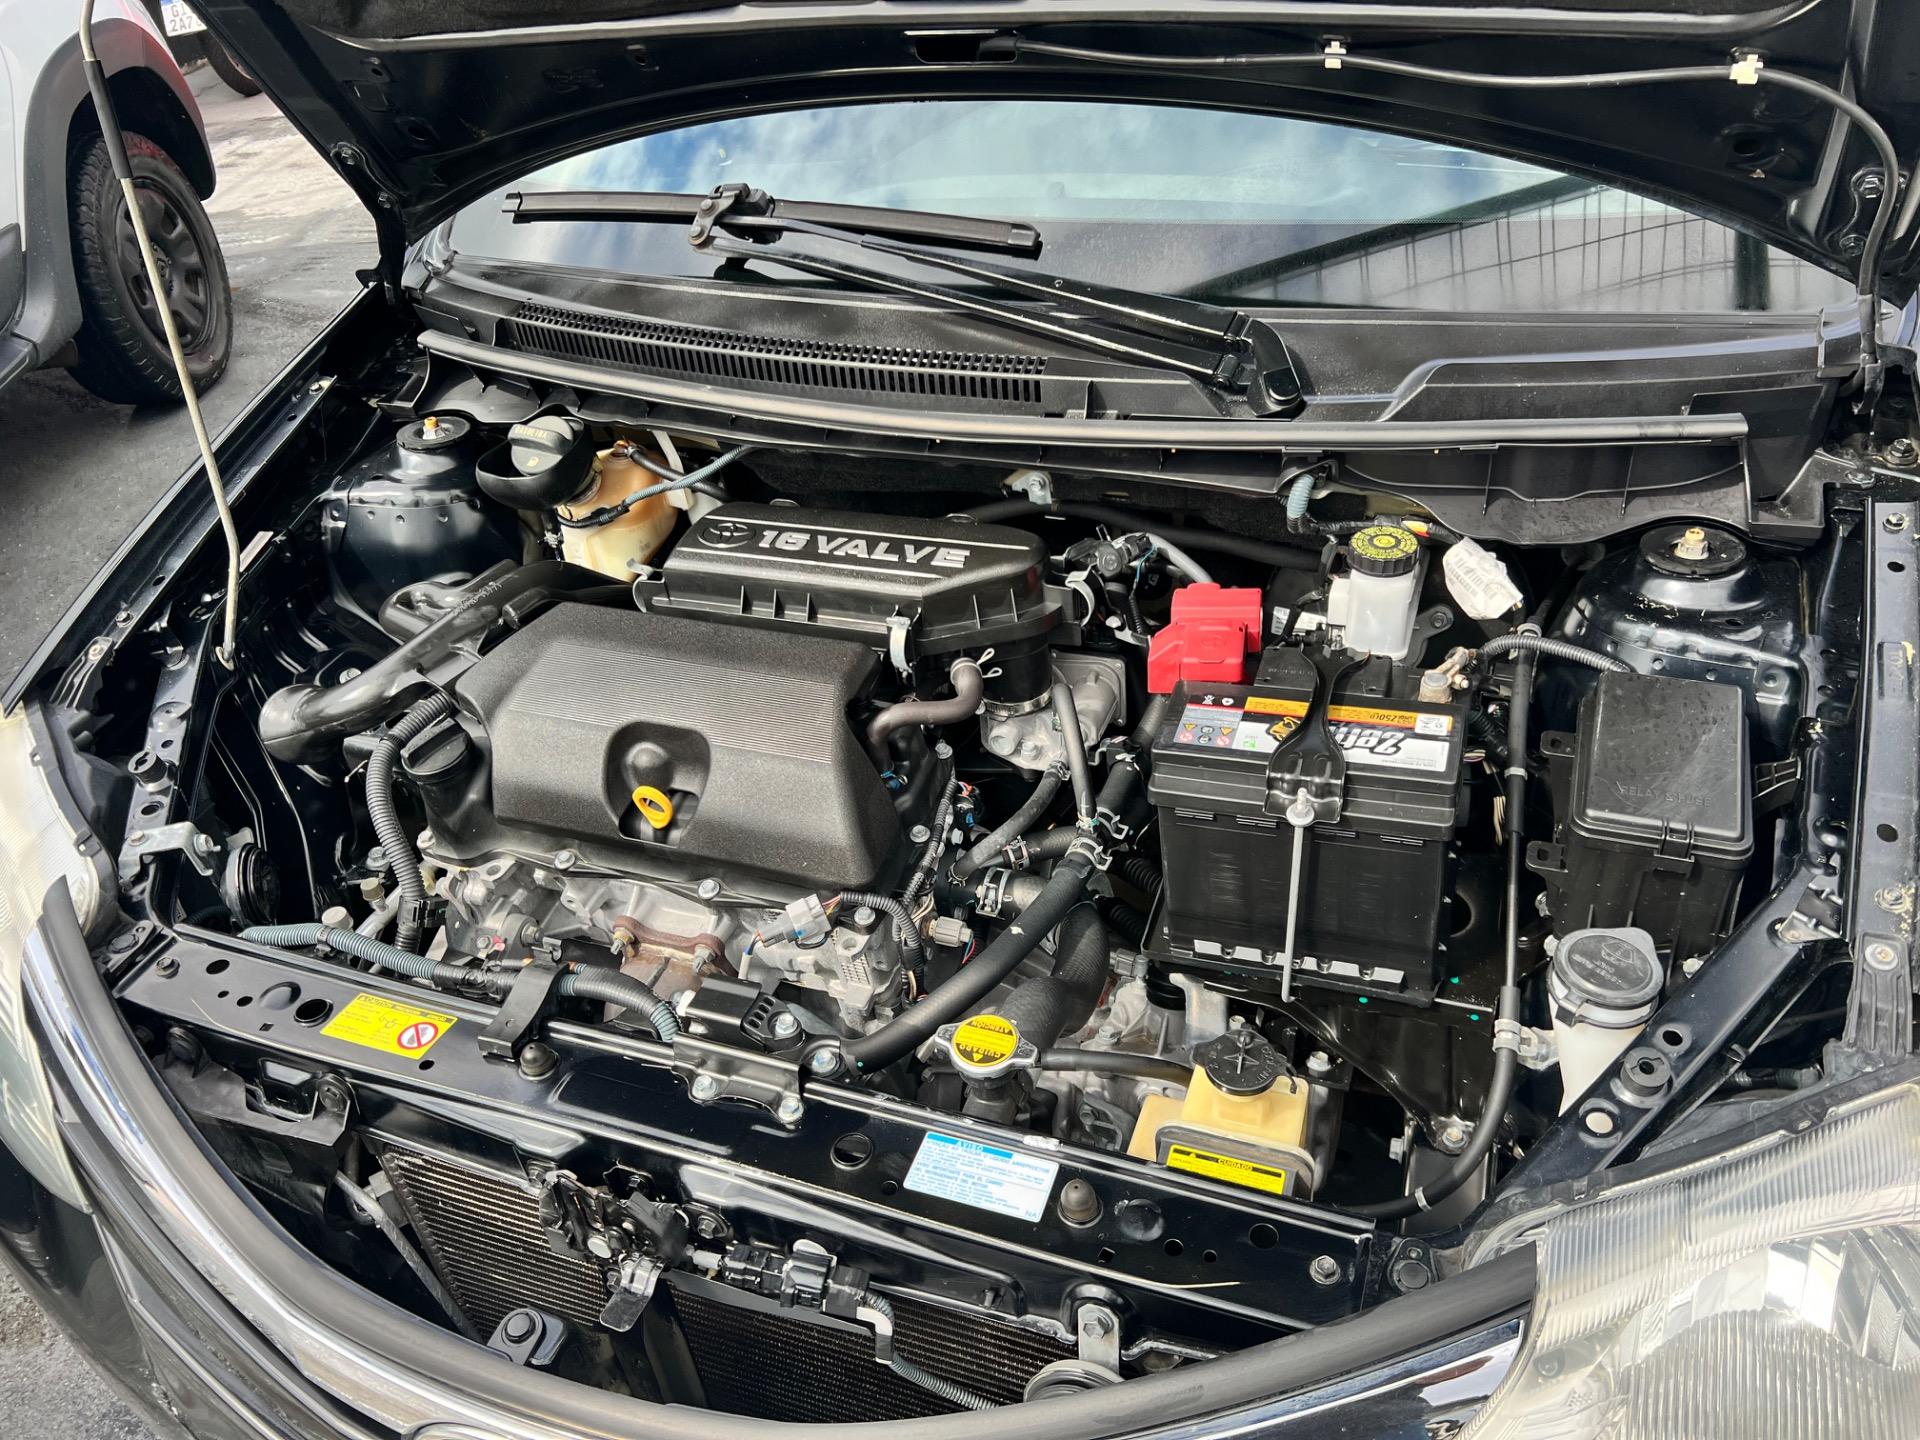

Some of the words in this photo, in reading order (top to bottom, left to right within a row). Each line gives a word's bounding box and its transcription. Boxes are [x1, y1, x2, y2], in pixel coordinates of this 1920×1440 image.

[759, 530, 811, 550] 16
[817, 535, 971, 568] VALVE
[959, 1043, 1001, 1059] CUIDADO
[1218, 1158, 1253, 1171] CUIDADO
